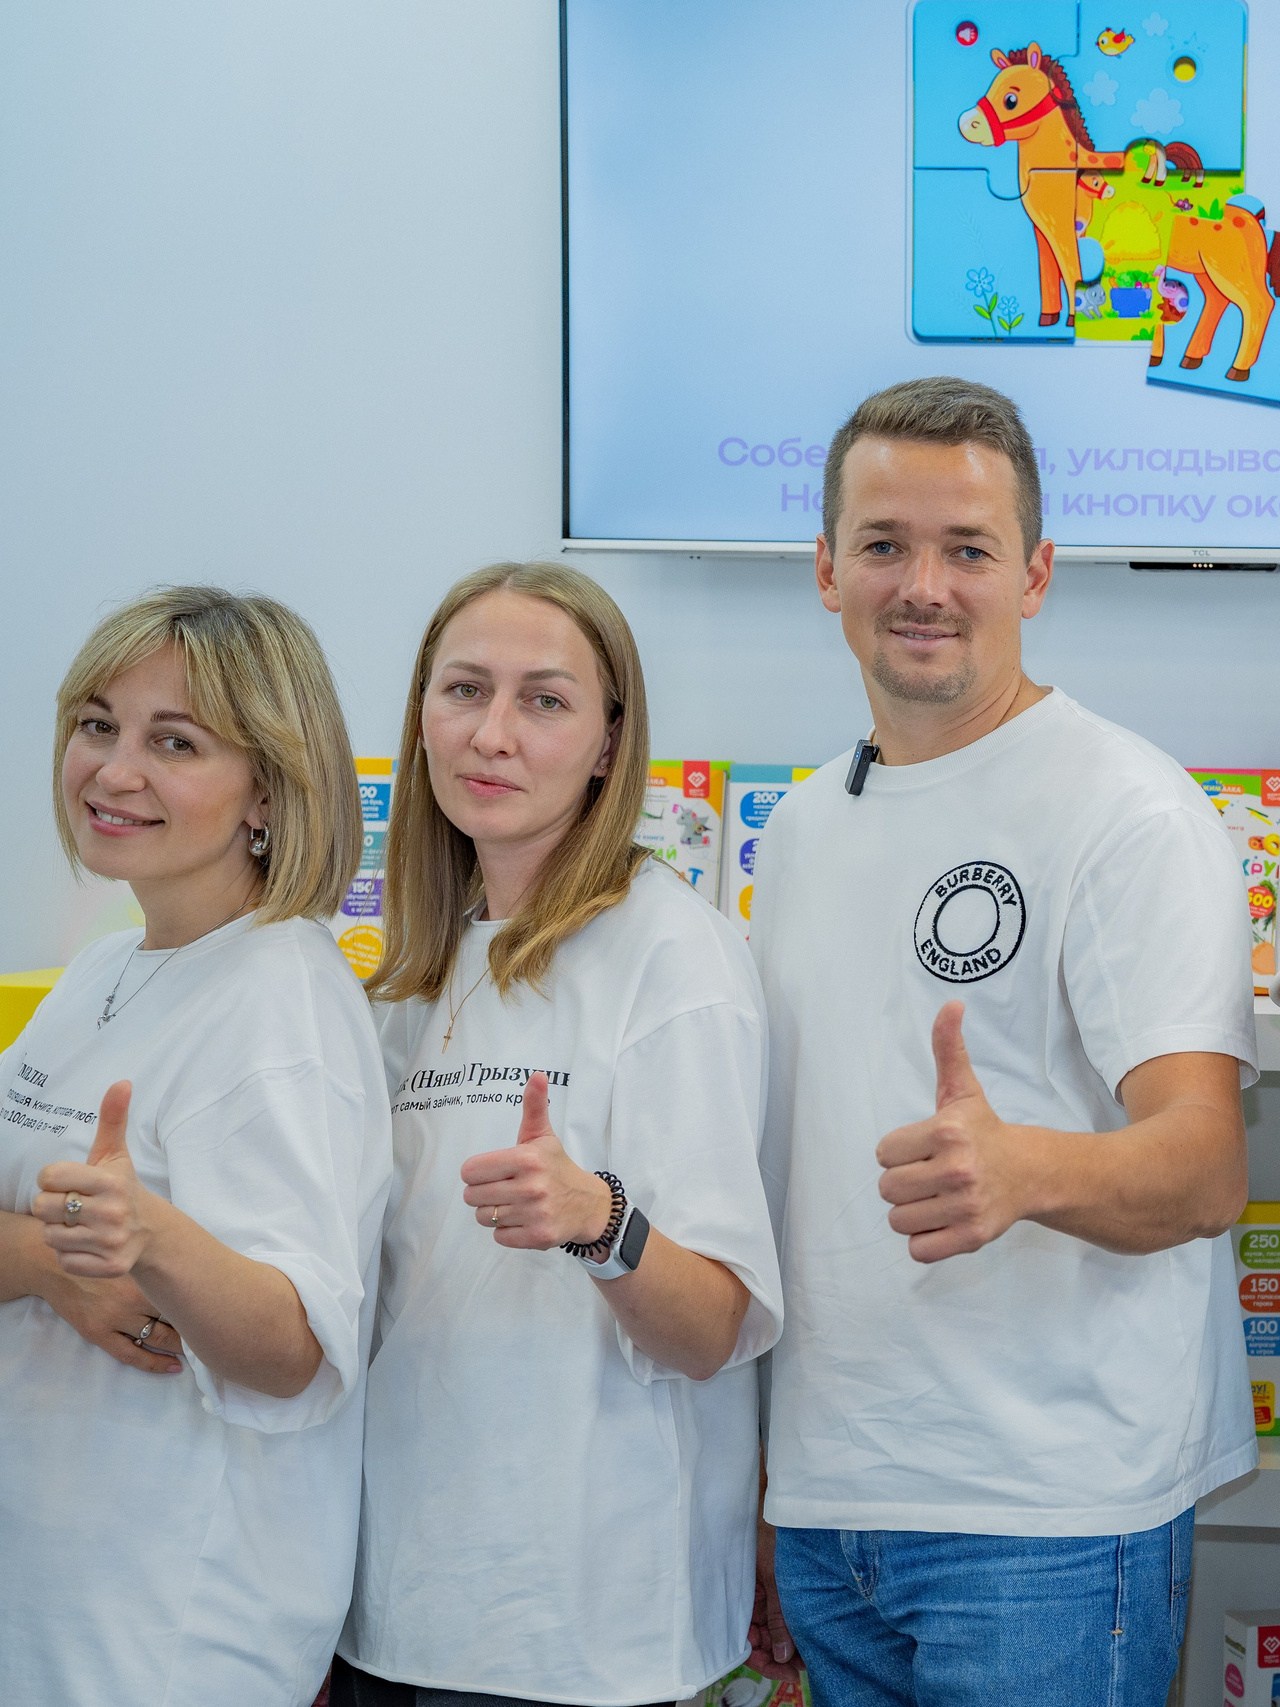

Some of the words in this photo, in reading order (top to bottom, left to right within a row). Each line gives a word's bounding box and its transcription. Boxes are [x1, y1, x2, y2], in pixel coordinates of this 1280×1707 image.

[717, 437, 828, 467] Собе
[1062, 493, 1217, 523] кнопку
[752, 791, 779, 804] 200
[934, 867, 1017, 907] BURBERRY
[920, 938, 1002, 976] ENGLAND
[411, 1064, 467, 1092] (Няня)
[400, 1097, 432, 1112] самый
[432, 1095, 463, 1109] зайчик,
[466, 1093, 503, 1104] только
[7, 1110, 27, 1124] 100
[1249, 1234, 1279, 1249] 250
[1250, 1278, 1279, 1293] 150
[1249, 1320, 1278, 1335] 100
